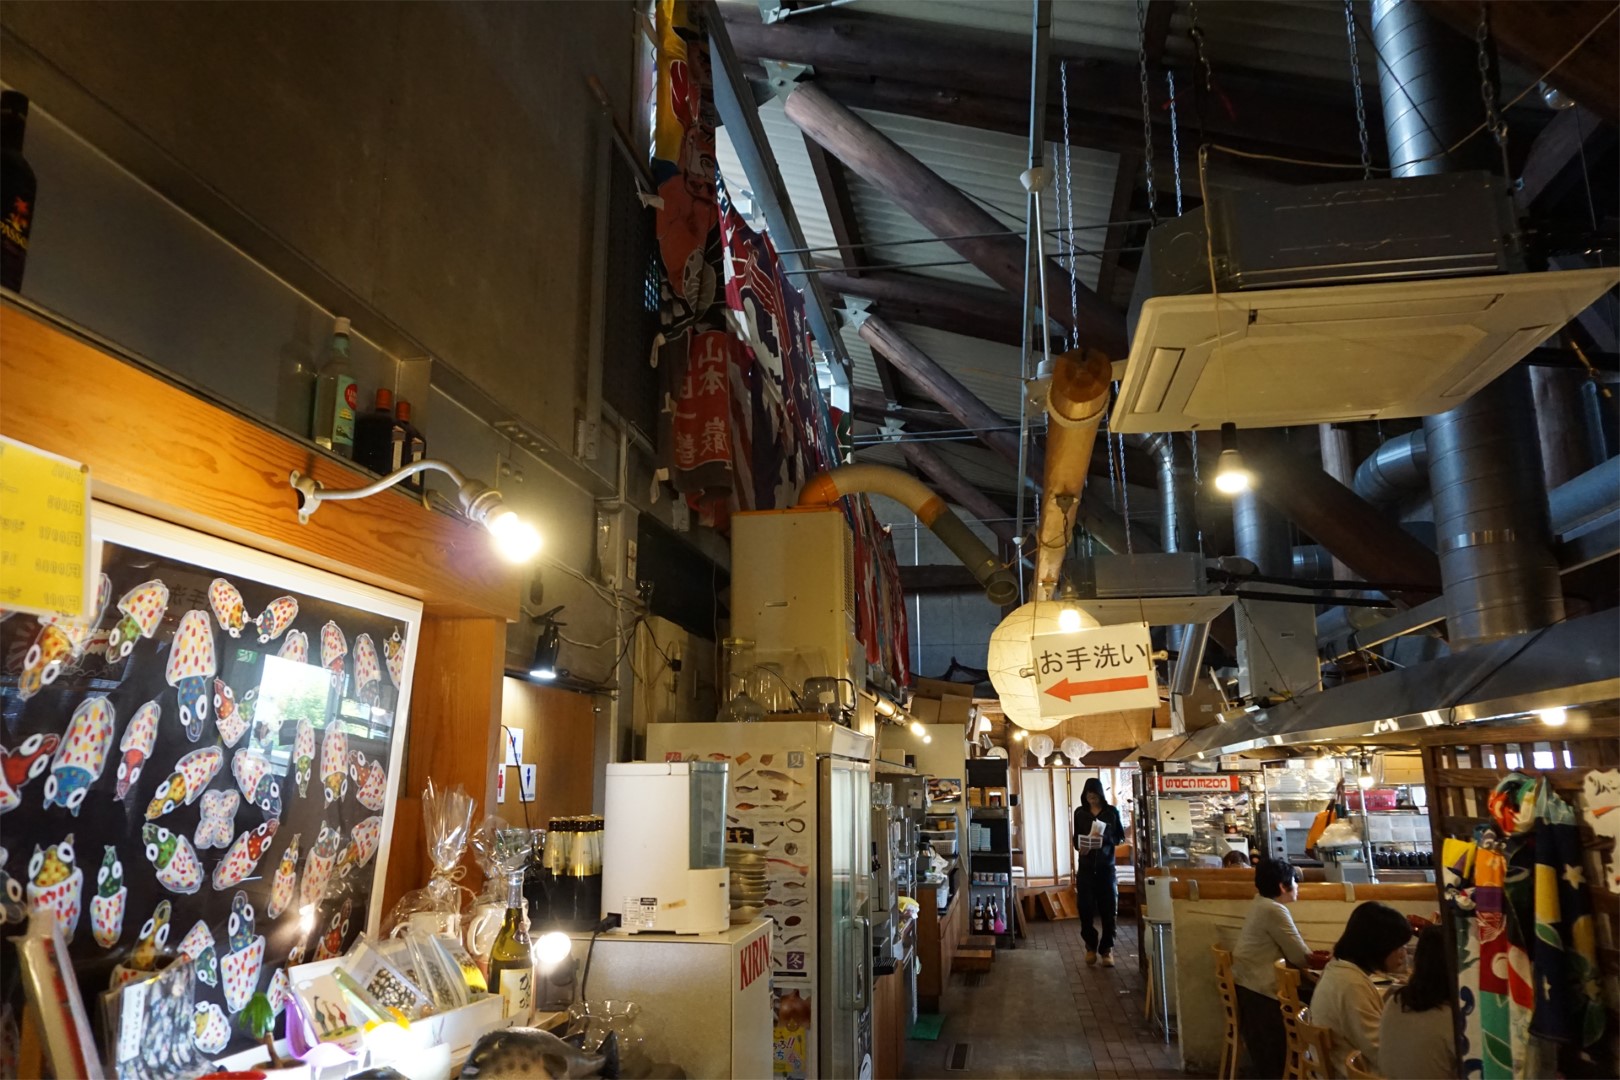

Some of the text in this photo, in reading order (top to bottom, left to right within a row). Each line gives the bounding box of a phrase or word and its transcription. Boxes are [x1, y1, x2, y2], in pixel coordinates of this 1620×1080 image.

[1040, 643, 1146, 675] お手洗い
[740, 932, 770, 991] KIRIN
[788, 953, 803, 969] 冬
